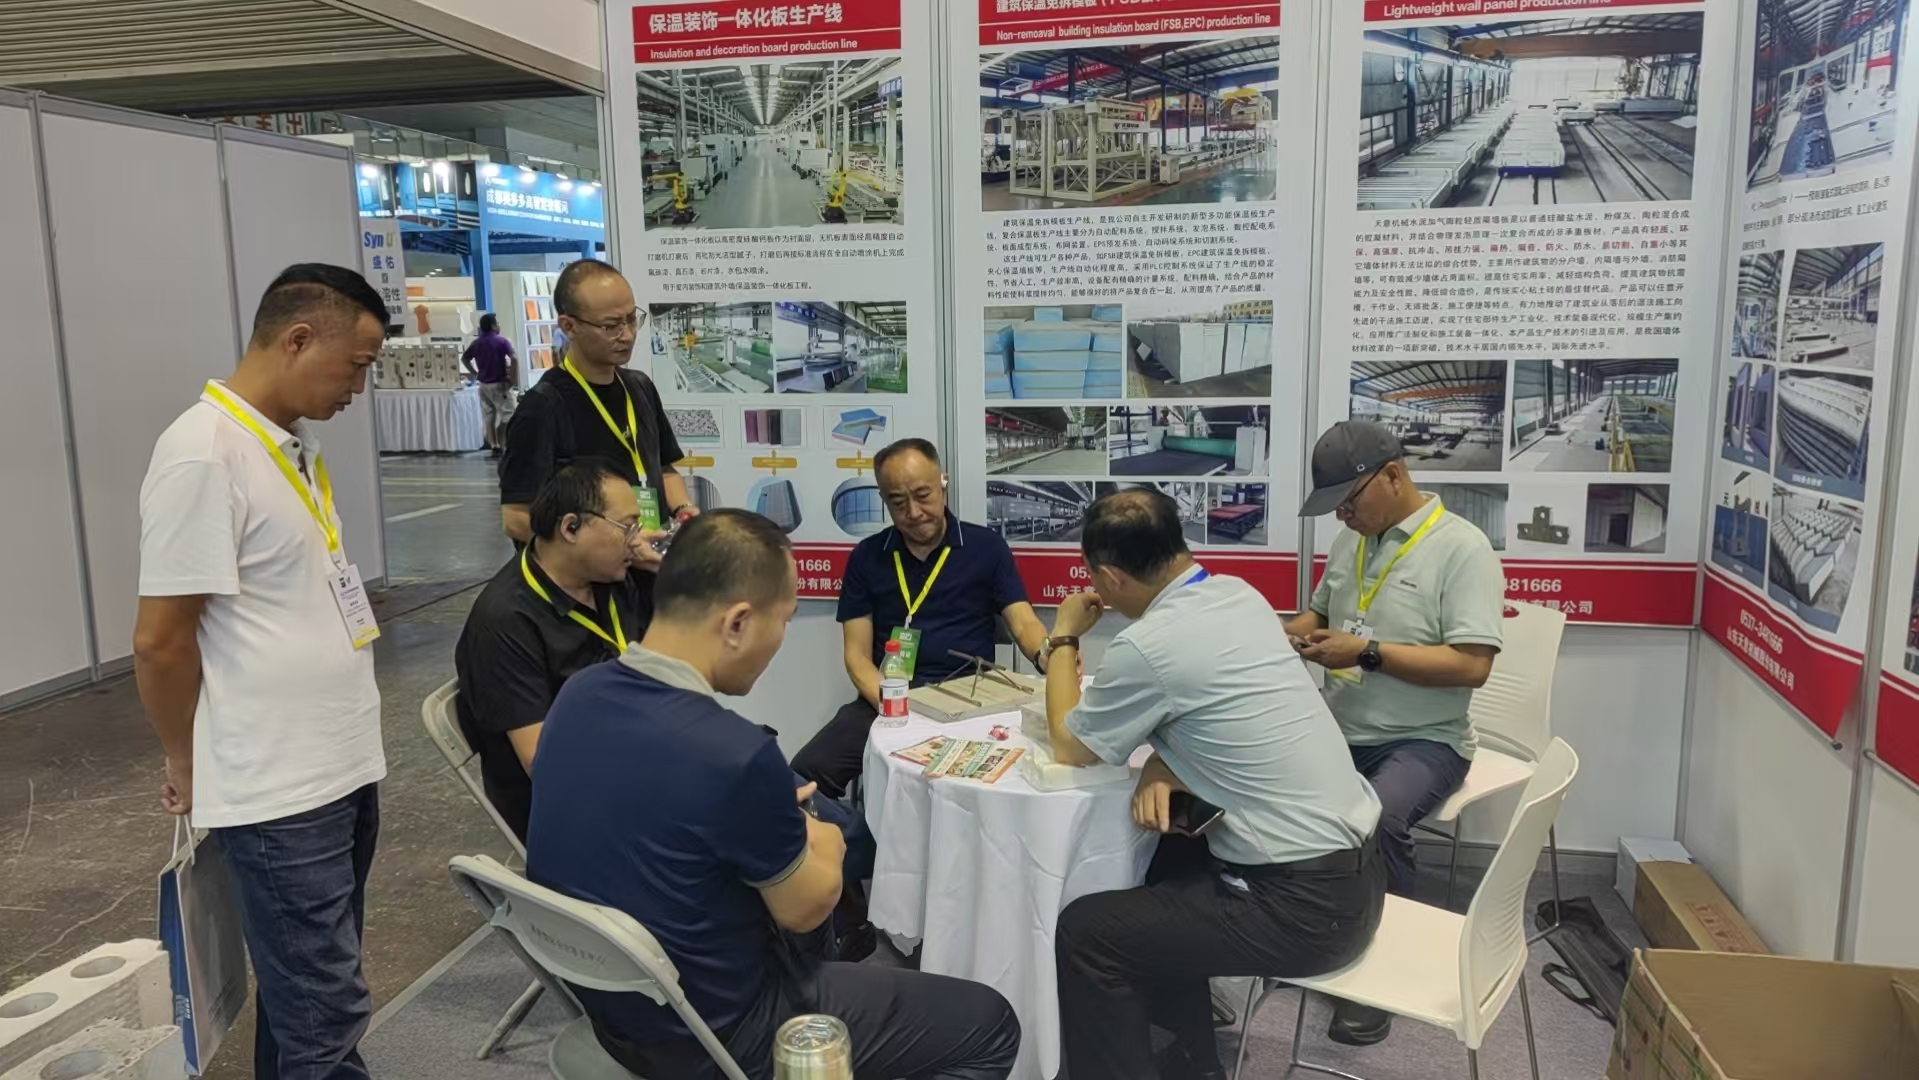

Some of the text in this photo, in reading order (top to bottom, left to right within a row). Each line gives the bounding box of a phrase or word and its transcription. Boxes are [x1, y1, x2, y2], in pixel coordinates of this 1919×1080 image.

[649, 4, 843, 34] 保温装饰一体化板生产线
[1383, 0, 1454, 19] Lightweight
[1457, 0, 1481, 12] wall
[1483, 0, 1518, 12] panel
[1059, 26, 1091, 39] building
[1093, 22, 1133, 35] insulation
[1135, 21, 1159, 32] board
[1160, 17, 1205, 32] (FSB,EPC)
[1207, 14, 1253, 29] production
[1254, 13, 1271, 24] line
[650, 38, 858, 60] Insulation and decoration board production line
[1069, 565, 1092, 580] 05
